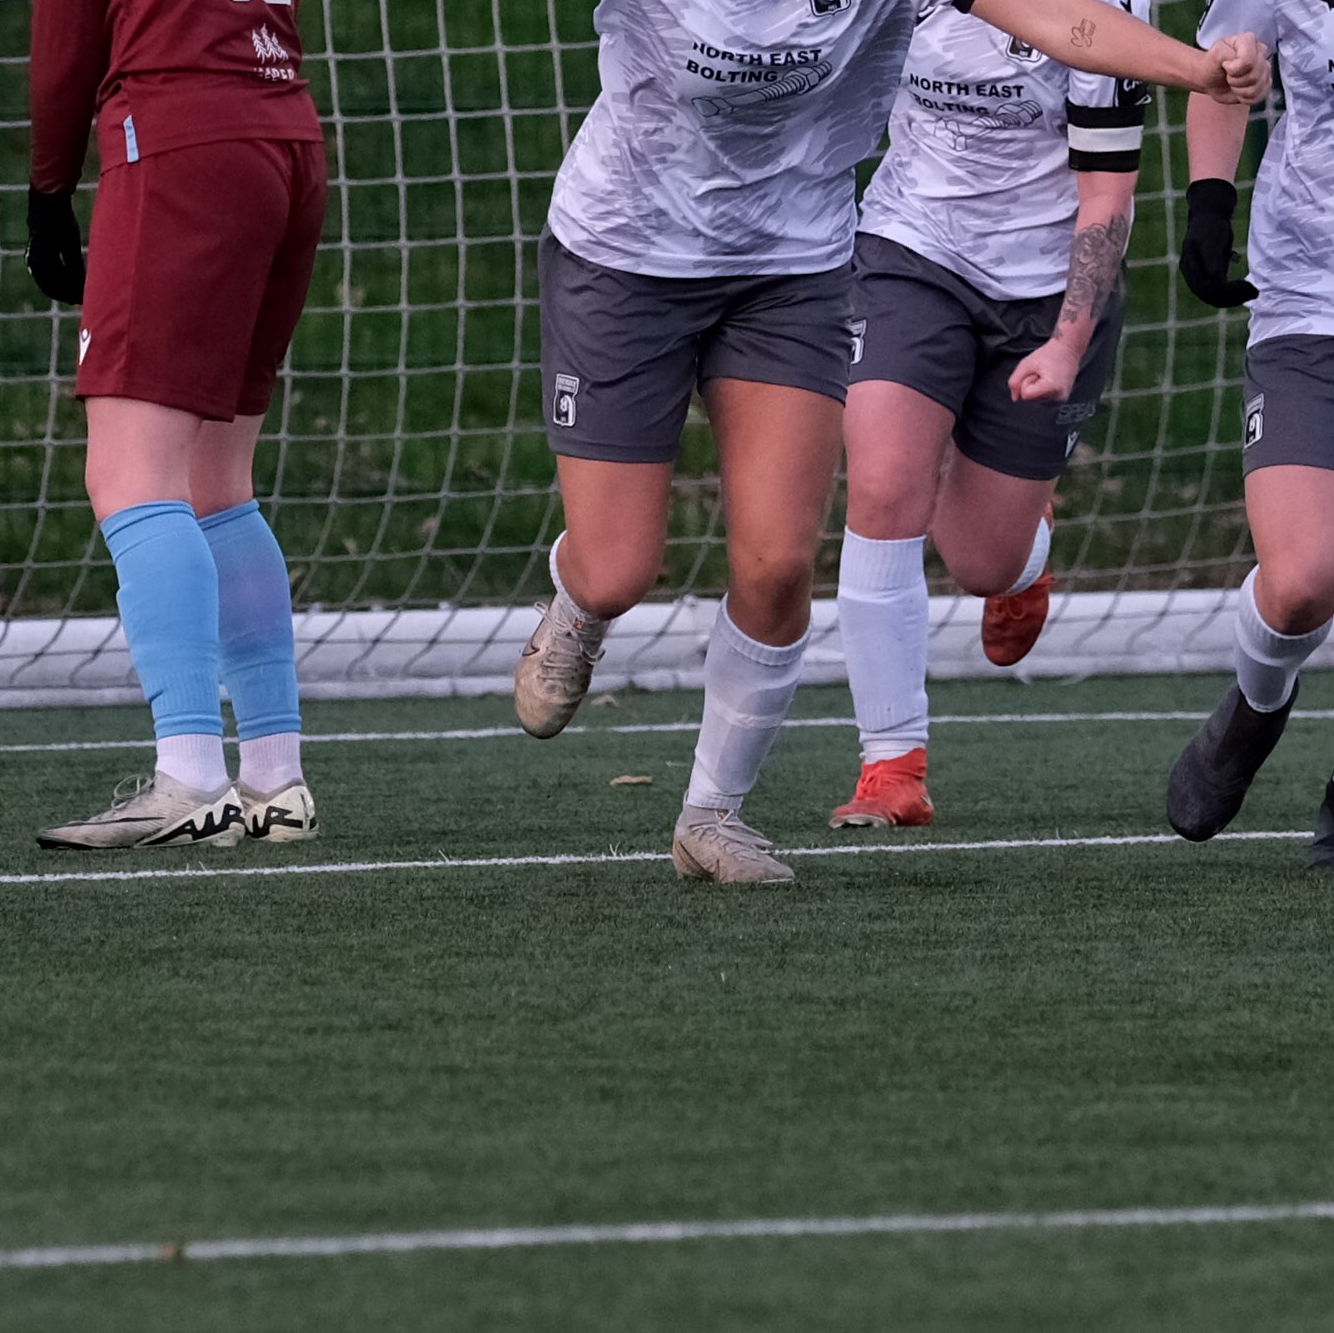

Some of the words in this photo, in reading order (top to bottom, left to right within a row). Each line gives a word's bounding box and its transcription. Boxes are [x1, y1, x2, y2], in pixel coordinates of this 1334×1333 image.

[692, 42, 763, 66] NORTH
[770, 49, 822, 66] EAST
[686, 59, 778, 83] BOLTING
[910, 73, 970, 96] NORTH
[976, 84, 1024, 98] EAST
[912, 92, 989, 116] BOLTING
